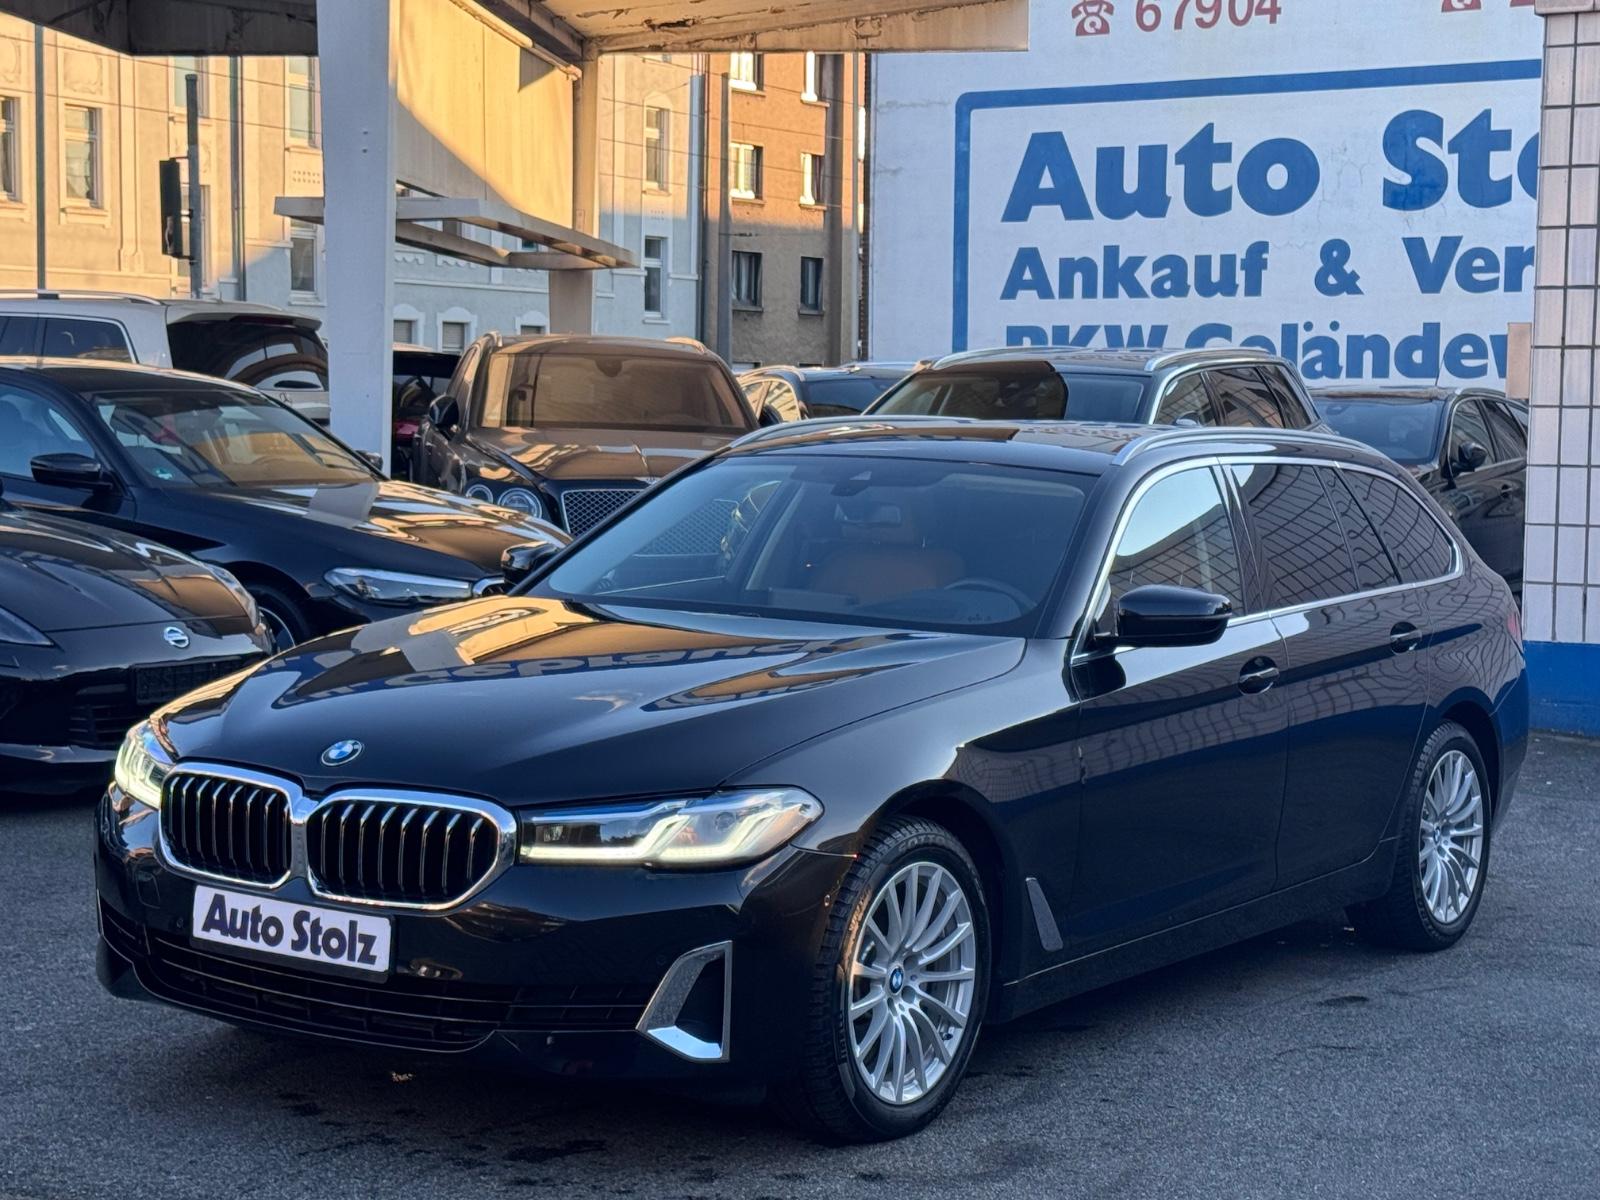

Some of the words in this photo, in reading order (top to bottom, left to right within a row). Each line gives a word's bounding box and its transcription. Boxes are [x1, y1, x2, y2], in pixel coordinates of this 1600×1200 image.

[1000, 121, 1321, 222] Auto
[999, 241, 1270, 300] Ankauf
[1314, 238, 1365, 296] &
[1401, 235, 1536, 294] Ver
[201, 893, 285, 947] Auto
[290, 909, 378, 965] Stolz
